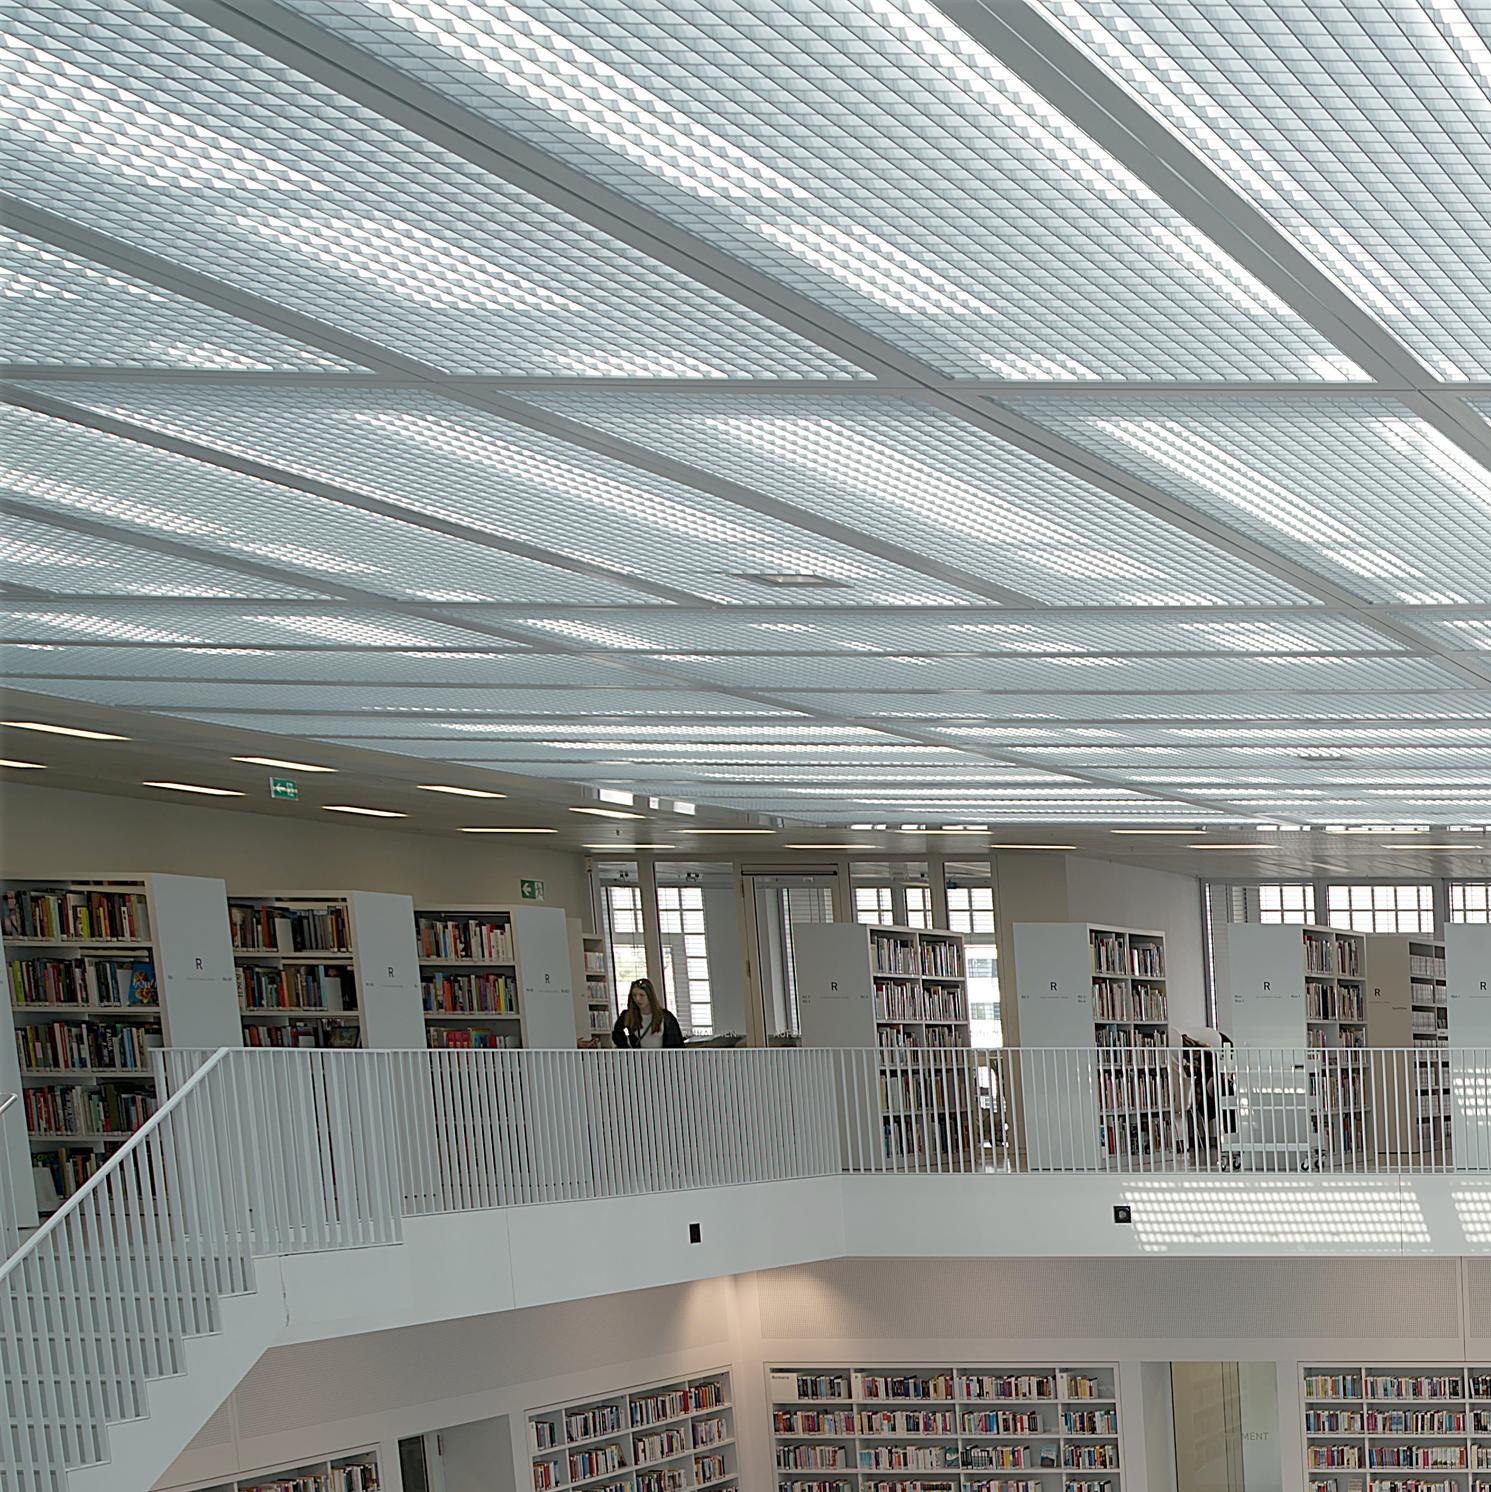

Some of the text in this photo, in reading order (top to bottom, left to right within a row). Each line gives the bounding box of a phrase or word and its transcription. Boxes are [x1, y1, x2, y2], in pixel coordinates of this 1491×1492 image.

[195, 957, 203, 970] R
[388, 966, 394, 978] R
[544, 973, 550, 984] R
[831, 981, 838, 991] R
[1050, 981, 1057, 991] R
[1263, 981, 1271, 991] R
[1479, 981, 1487, 991] R
[1374, 988, 1381, 997] R
